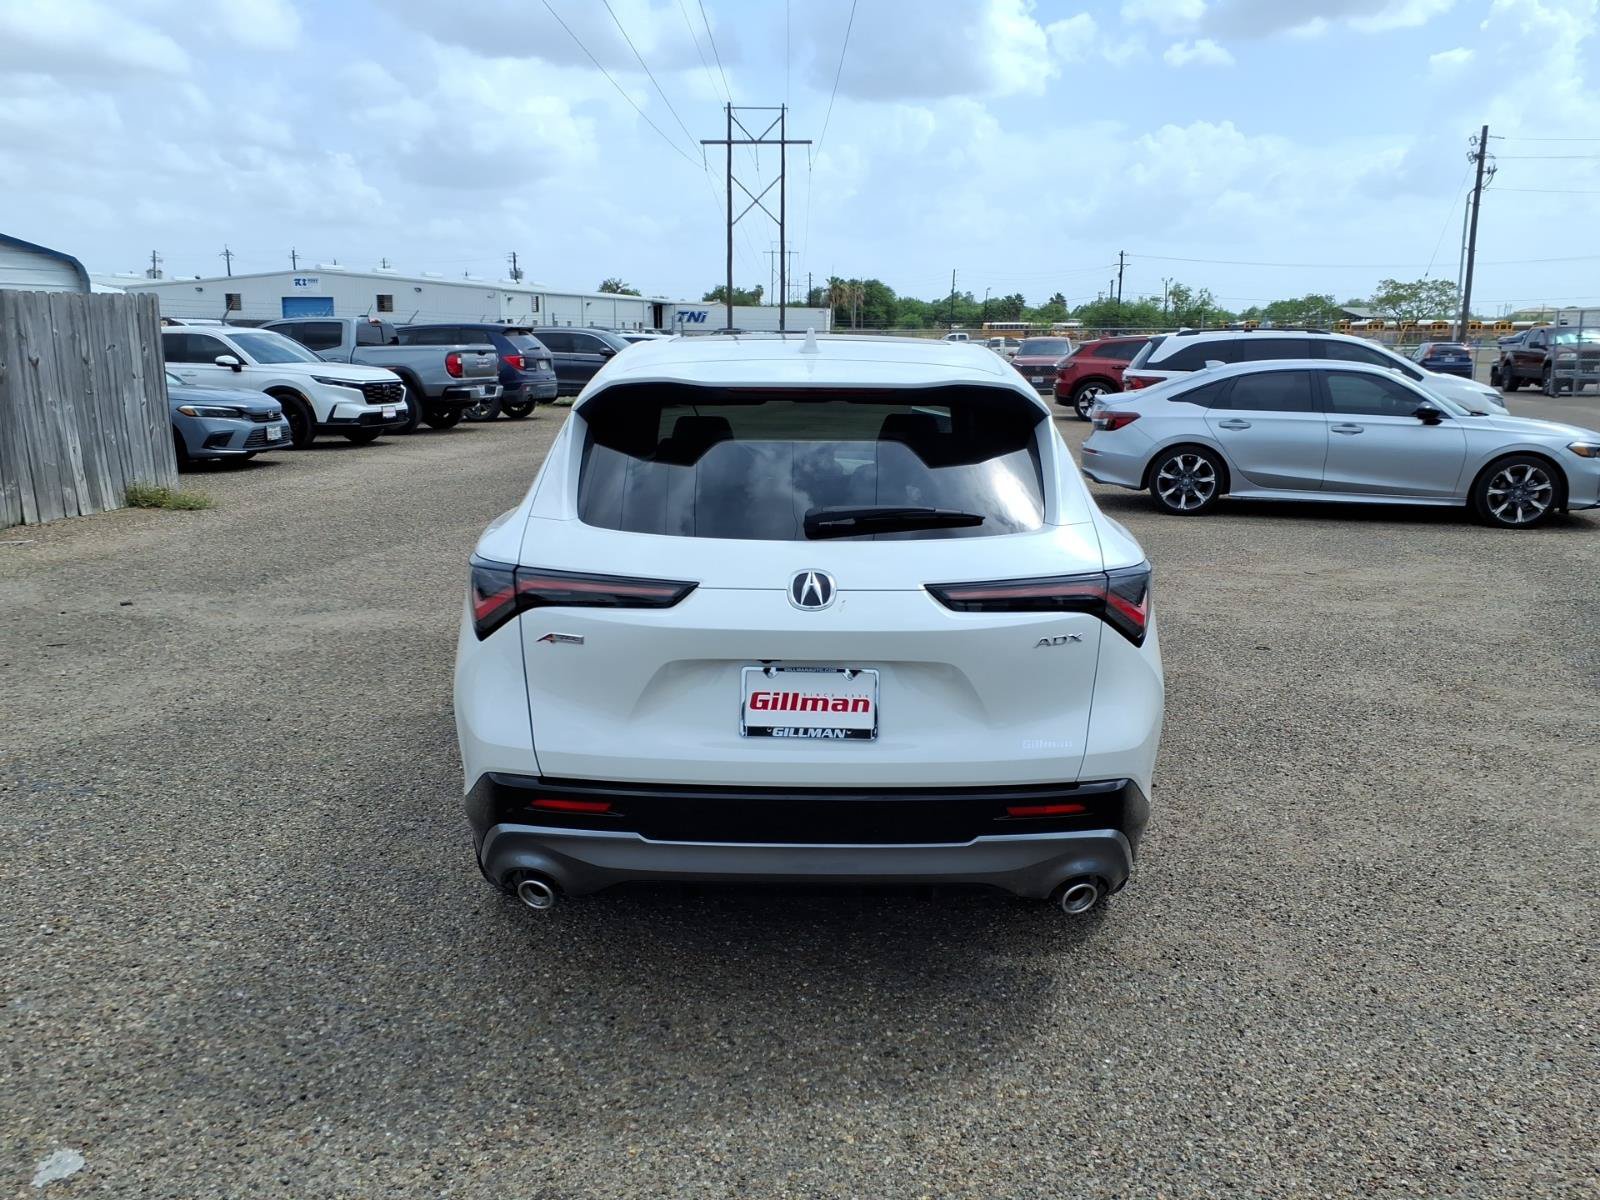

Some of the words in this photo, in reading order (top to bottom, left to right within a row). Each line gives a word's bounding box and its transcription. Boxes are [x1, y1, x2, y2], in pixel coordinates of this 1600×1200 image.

[1033, 634, 1082, 648] ADX
[750, 692, 870, 712] Gillman
[772, 728, 846, 738] GILLMAN
